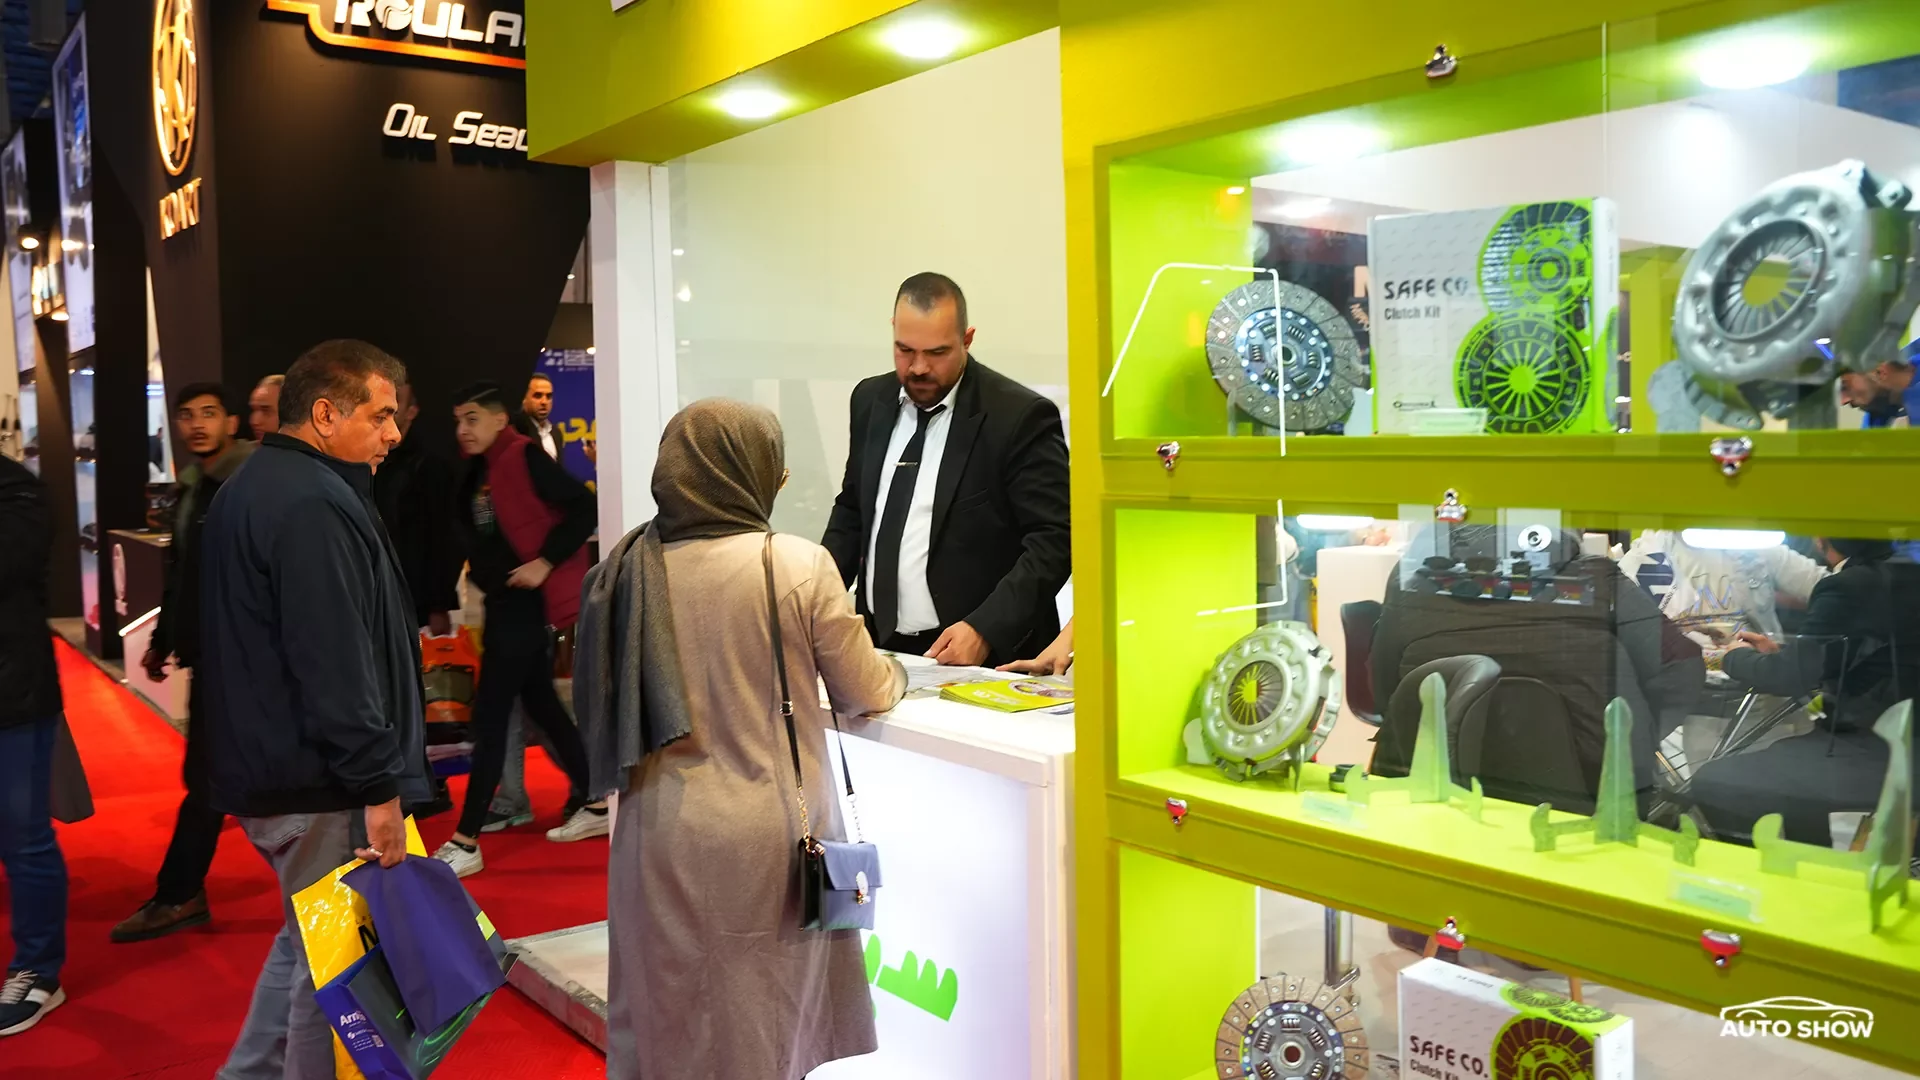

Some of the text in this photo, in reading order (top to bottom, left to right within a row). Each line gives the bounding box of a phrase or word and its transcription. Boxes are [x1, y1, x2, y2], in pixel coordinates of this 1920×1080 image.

[1384, 279, 1436, 300] SAFE
[1384, 307, 1421, 320] Clutch
[1424, 305, 1441, 318] Kit
[1410, 1035, 1489, 1079] SAFE CO.
